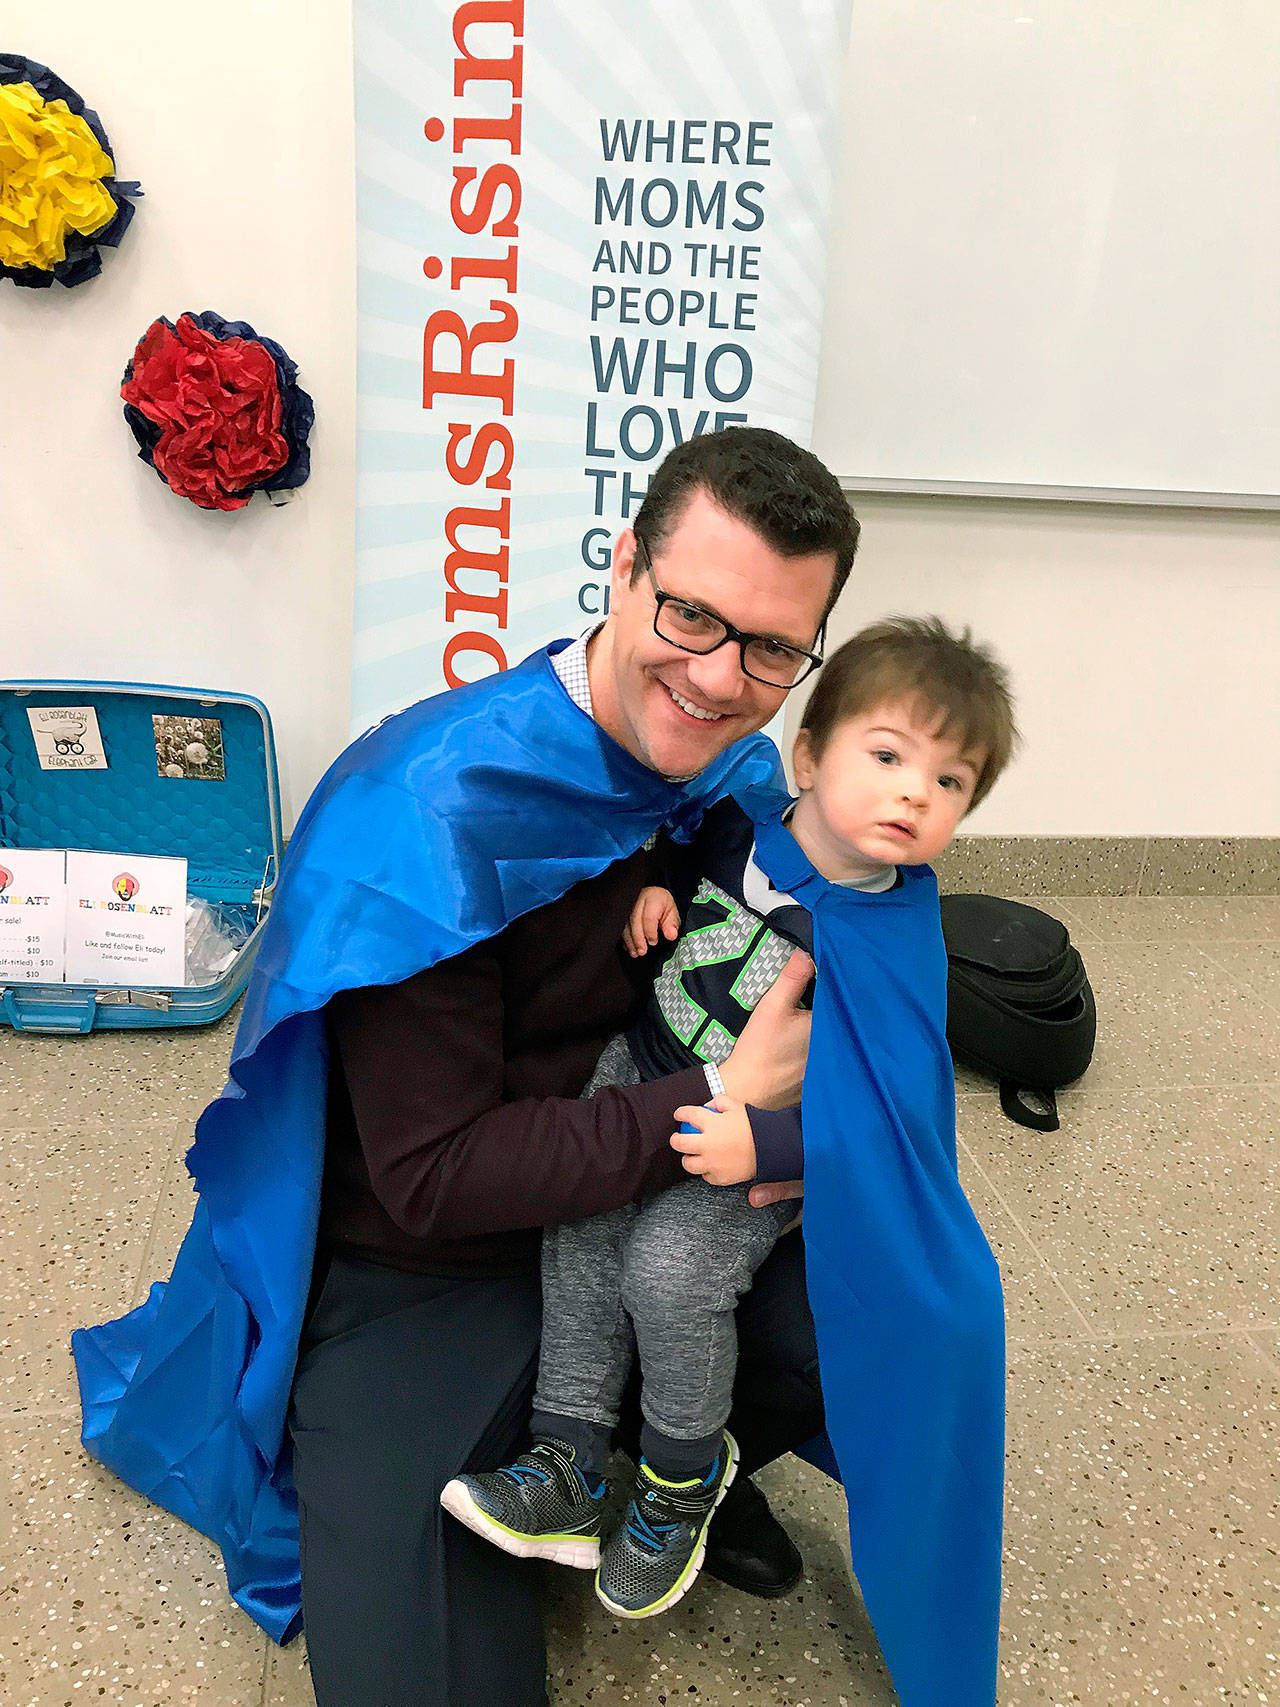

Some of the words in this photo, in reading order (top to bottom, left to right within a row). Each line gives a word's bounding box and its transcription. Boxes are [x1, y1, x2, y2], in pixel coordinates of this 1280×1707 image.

[599, 118, 773, 166] WHERE
[594, 176, 765, 232] MOMS
[592, 239, 672, 275] AND
[684, 243, 762, 280] THE
[591, 285, 758, 331] PEOPLE
[590, 335, 753, 403] WHO
[100, 901, 173, 916] ROSENBLATT
[27, 947, 40, 955] $10
[84, 940, 98, 949] Like
[113, 942, 133, 951] follow
[135, 944, 144, 952] Eli
[145, 946, 166, 956] today!
[26, 971, 40, 979] $10
[40, 959, 54, 967] $10
